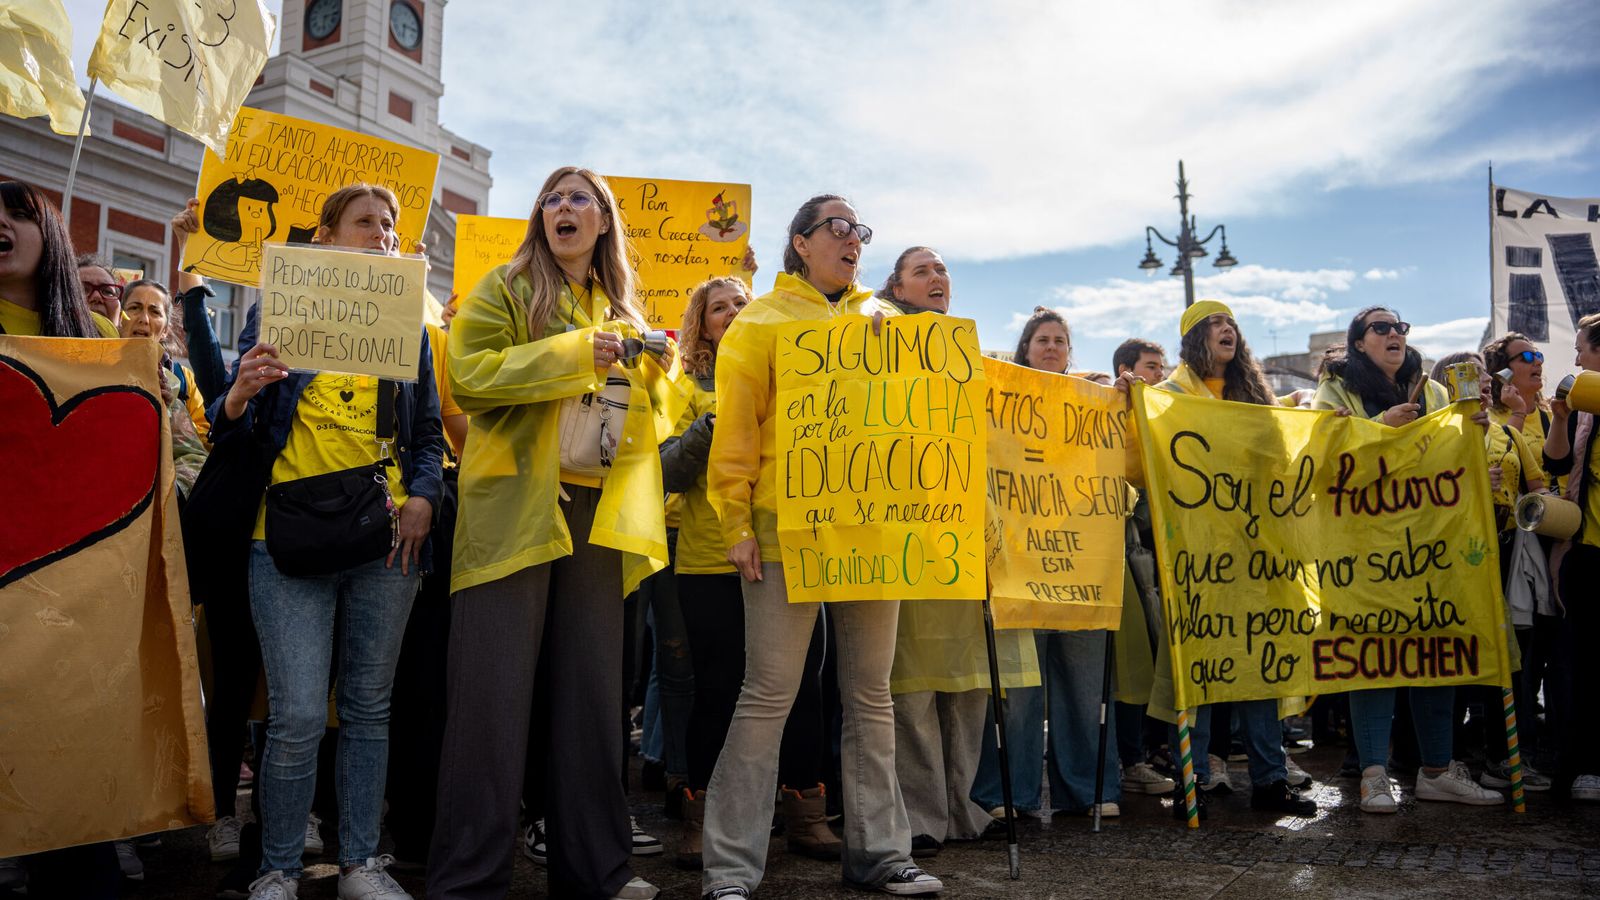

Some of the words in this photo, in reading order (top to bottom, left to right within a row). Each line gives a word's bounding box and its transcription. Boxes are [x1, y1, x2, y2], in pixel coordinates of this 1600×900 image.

[195, 0, 236, 46] -3
[268, 121, 316, 155] TANTO
[324, 136, 404, 178] AHORRAR
[291, 188, 321, 216] HEC
[636, 182, 669, 212] Pan
[1496, 188, 1561, 218] LA
[272, 256, 340, 288] PEDIMOS
[345, 269, 360, 289] LO
[655, 244, 709, 265] nosotras
[721, 255, 740, 265] no
[271, 292, 380, 327] DIGNIDAD
[648, 301, 665, 324] de
[268, 326, 412, 367] PROFESIONAL
[787, 393, 816, 420] en
[824, 379, 849, 419] la
[864, 377, 976, 435] LUCHA
[986, 387, 1047, 440] ATIOS
[316, 423, 328, 431] 0-3
[793, 421, 824, 448] por
[828, 418, 852, 442] la
[786, 436, 971, 499] EDUCACIÓN
[1169, 430, 1261, 539] Soy
[1269, 455, 1315, 517] el
[1327, 452, 1466, 517] futuro
[986, 467, 1072, 518] NFANCIA
[1074, 474, 1126, 520] SEGU
[806, 507, 836, 541] que
[884, 502, 966, 524] merecen
[1027, 527, 1084, 553] ALGETE
[902, 532, 960, 586] 0-3
[1174, 550, 1236, 605] que
[1315, 554, 1358, 589] no
[1368, 526, 1453, 583] sabe
[1026, 581, 1104, 603] PRESENTE
[1246, 607, 1321, 656] pero
[1329, 581, 1467, 635] necesita
[1190, 657, 1238, 701] que
[1260, 641, 1301, 685] lo
[1312, 634, 1479, 681] ESCUCHEN
